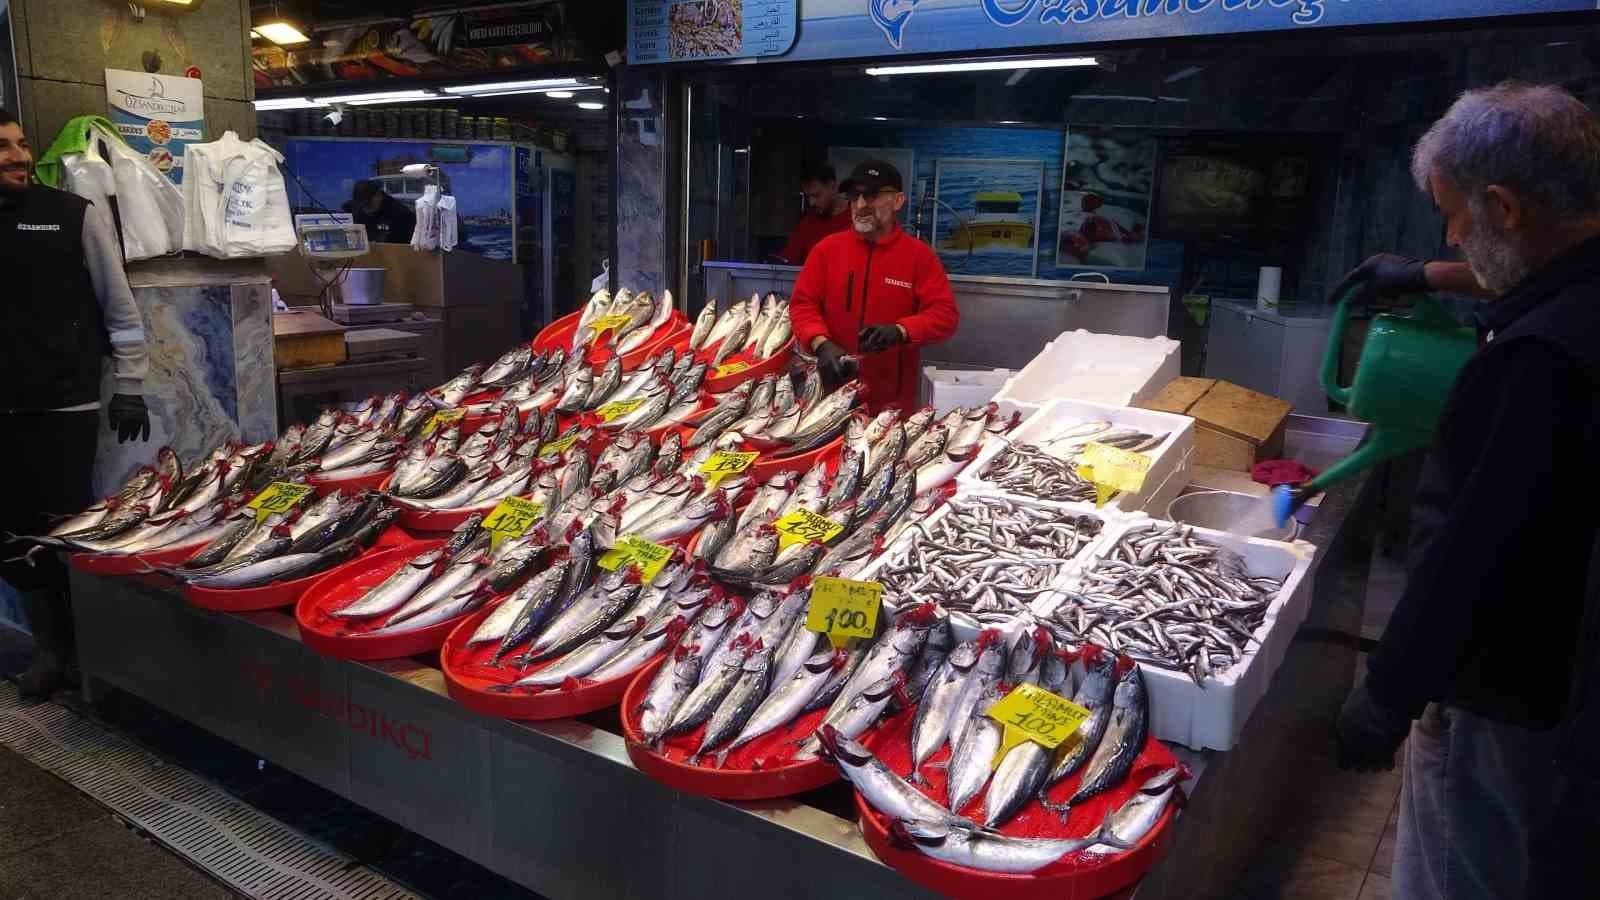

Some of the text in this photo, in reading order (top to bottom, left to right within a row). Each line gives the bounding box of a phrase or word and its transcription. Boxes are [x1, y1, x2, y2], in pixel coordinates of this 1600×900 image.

[494, 513, 529, 532] 125
[785, 521, 826, 540] 150
[824, 607, 867, 633] 100
[1021, 689, 1088, 721] PALAMUT
[1007, 711, 1056, 736] 100
